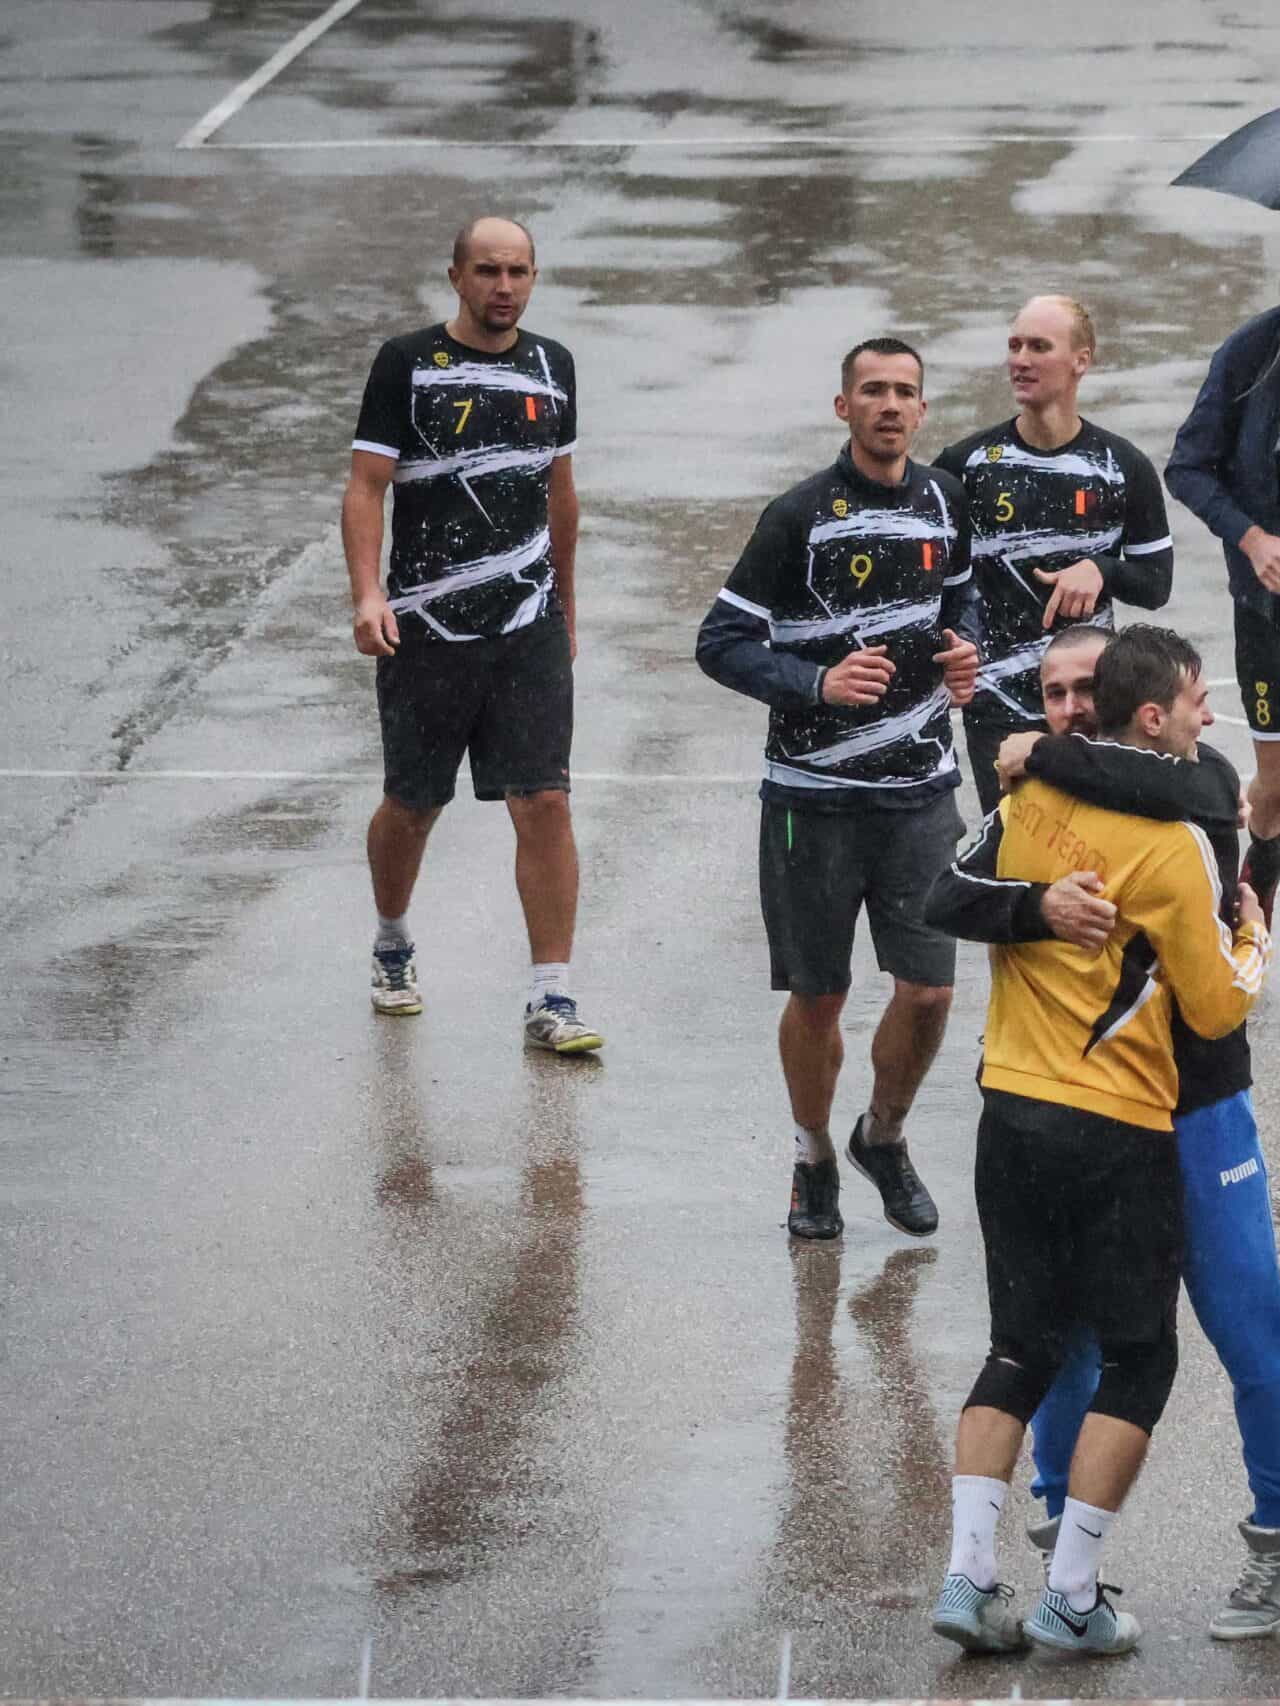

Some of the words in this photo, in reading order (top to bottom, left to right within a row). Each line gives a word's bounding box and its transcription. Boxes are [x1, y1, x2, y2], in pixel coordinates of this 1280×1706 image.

[453, 401, 472, 434] 7
[995, 492, 1014, 522] 5
[850, 554, 873, 589] 9
[1256, 697, 1270, 726] 8
[1219, 1158, 1258, 1186] PUMA
